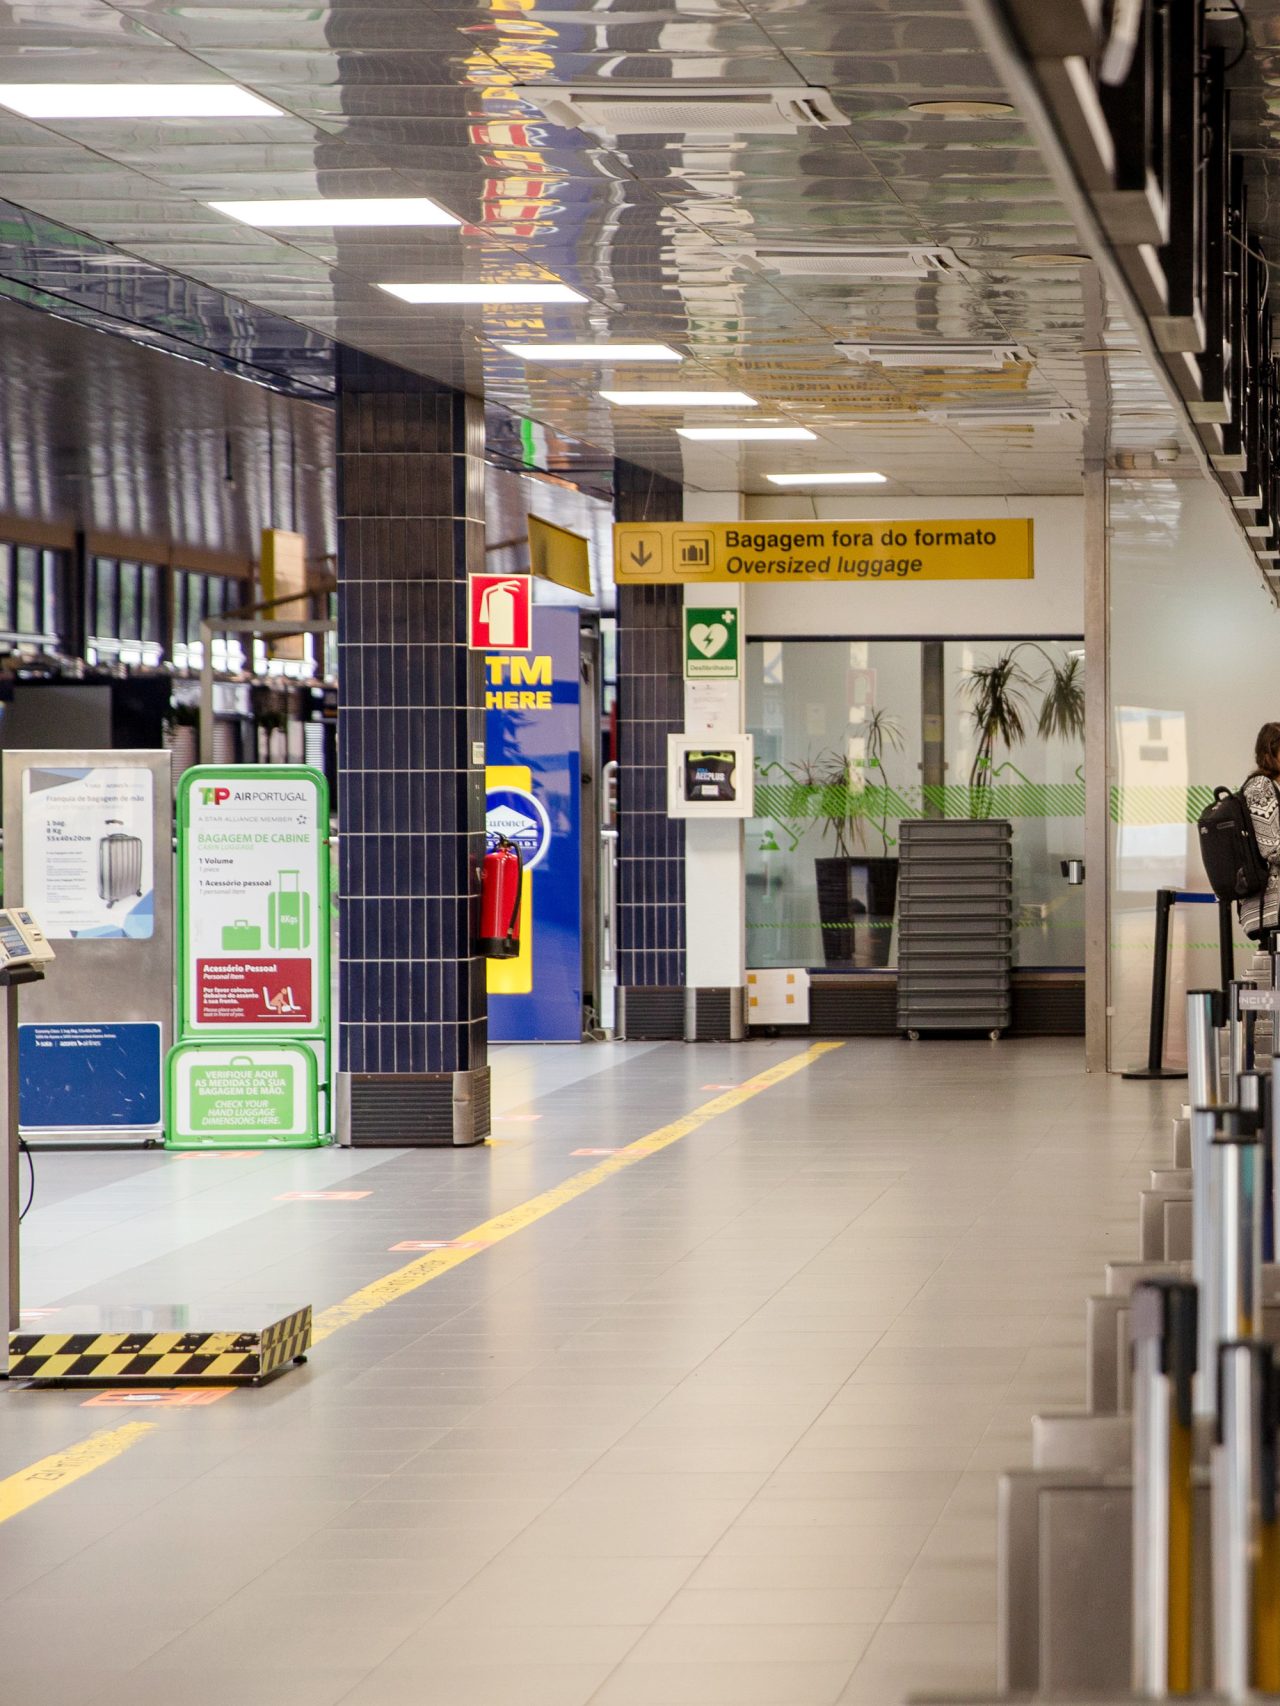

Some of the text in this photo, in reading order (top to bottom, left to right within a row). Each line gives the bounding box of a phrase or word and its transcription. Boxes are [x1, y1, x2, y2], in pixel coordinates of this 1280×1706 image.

[725, 529, 996, 549] Bagagem fora do formato
[726, 556, 923, 576] Oversized luggage
[485, 656, 552, 686] TM
[485, 691, 552, 710] HERE
[199, 788, 230, 805] TAP
[486, 820, 525, 828] uronet
[198, 833, 310, 843] BAGAGEM DE CABINE
[243, 880, 272, 888] pessoal
[203, 964, 277, 973] Acessório Pessoal
[205, 1071, 278, 1079] VERIFIQUE AQUI
[260, 1087, 285, 1095] MÃO.
